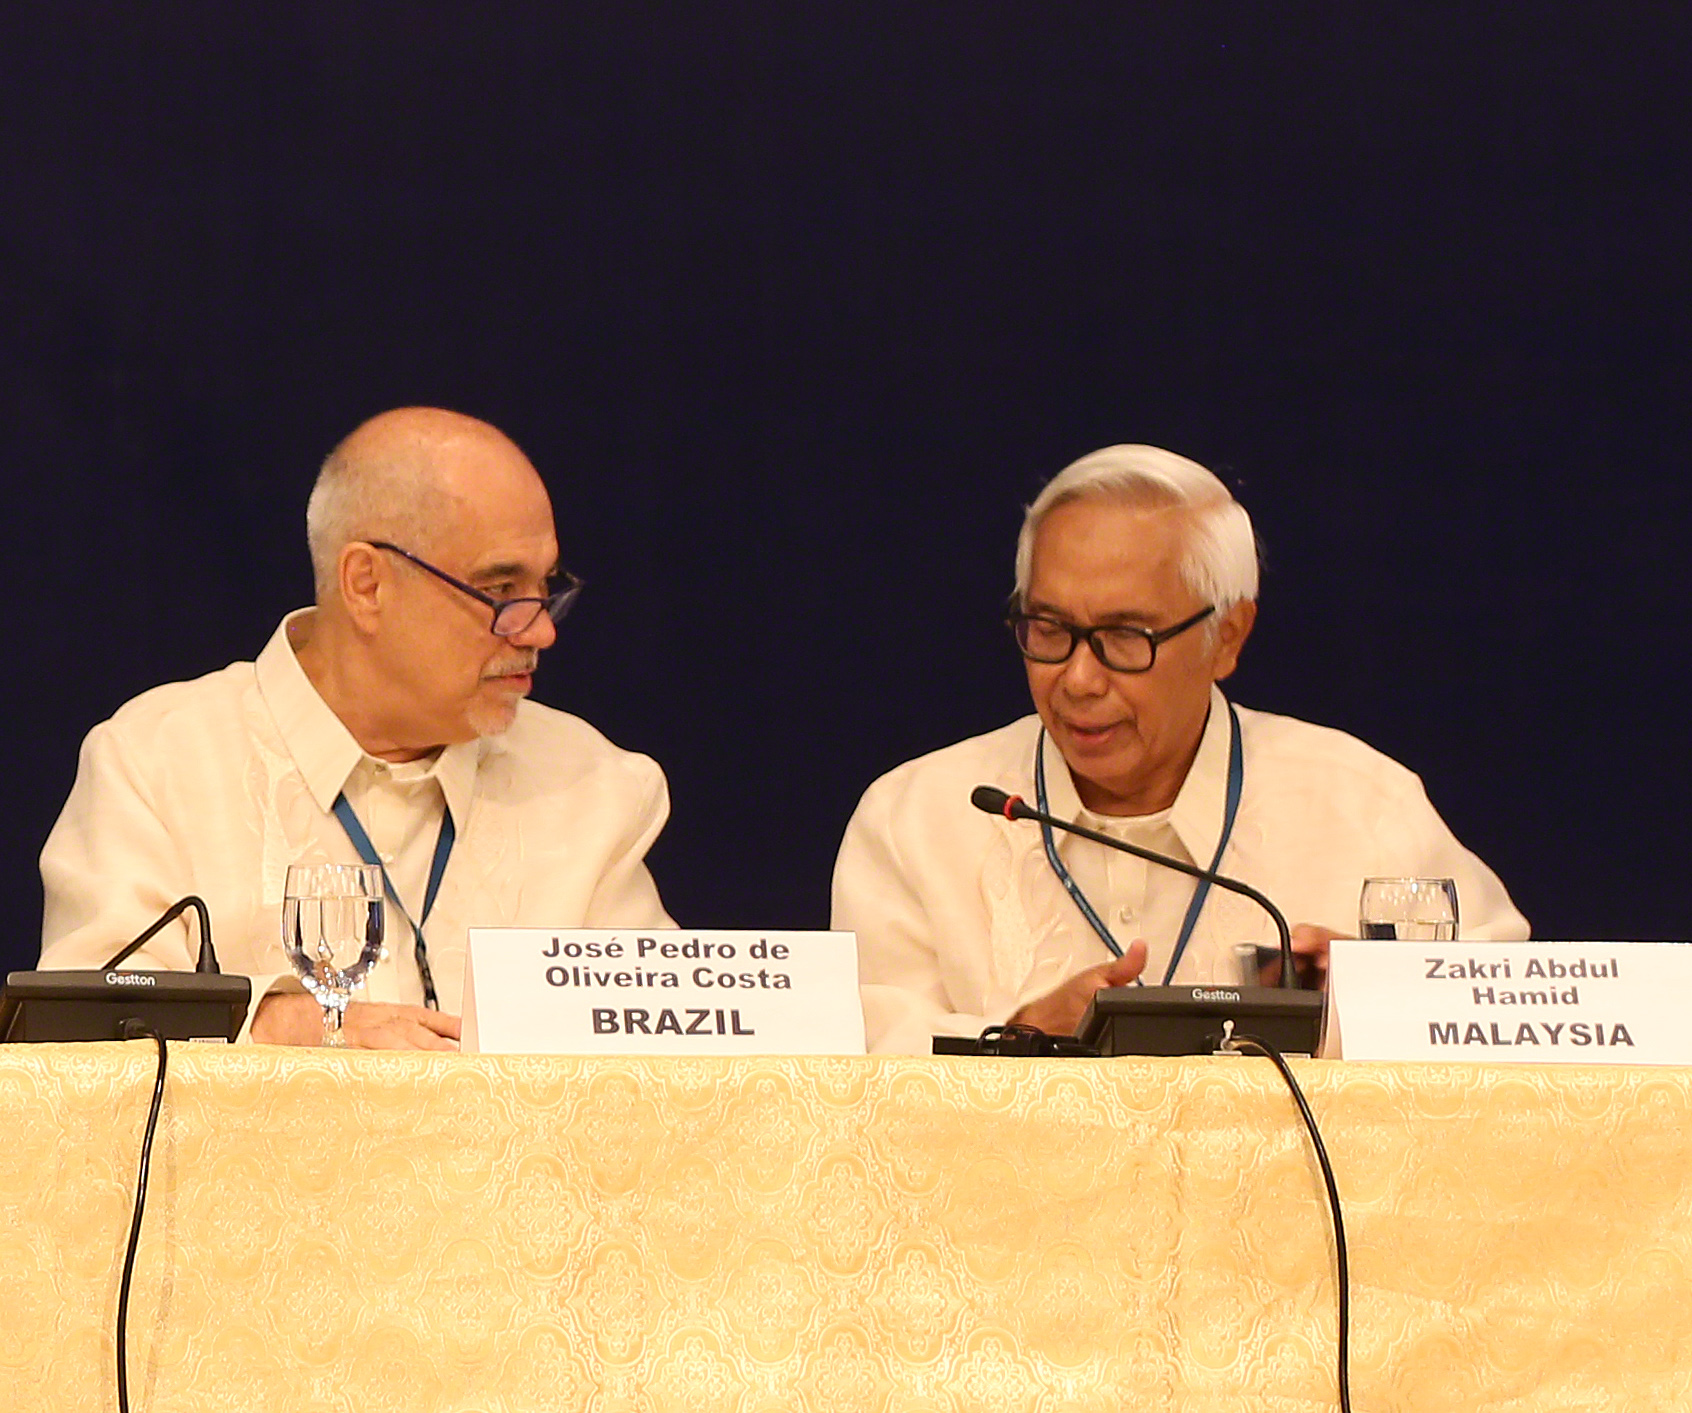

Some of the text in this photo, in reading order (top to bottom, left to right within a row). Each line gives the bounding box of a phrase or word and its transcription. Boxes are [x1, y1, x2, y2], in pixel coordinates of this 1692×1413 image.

[542, 937, 789, 960] José Pedro de
[106, 972, 156, 986] Gestton
[546, 966, 791, 989] Oliveira Costa
[1425, 958, 1618, 979] Zakri Abdul
[1472, 986, 1579, 1005] Hamid
[592, 1008, 755, 1035] BRAZIL
[1429, 1022, 1636, 1046] MALAYSIA
